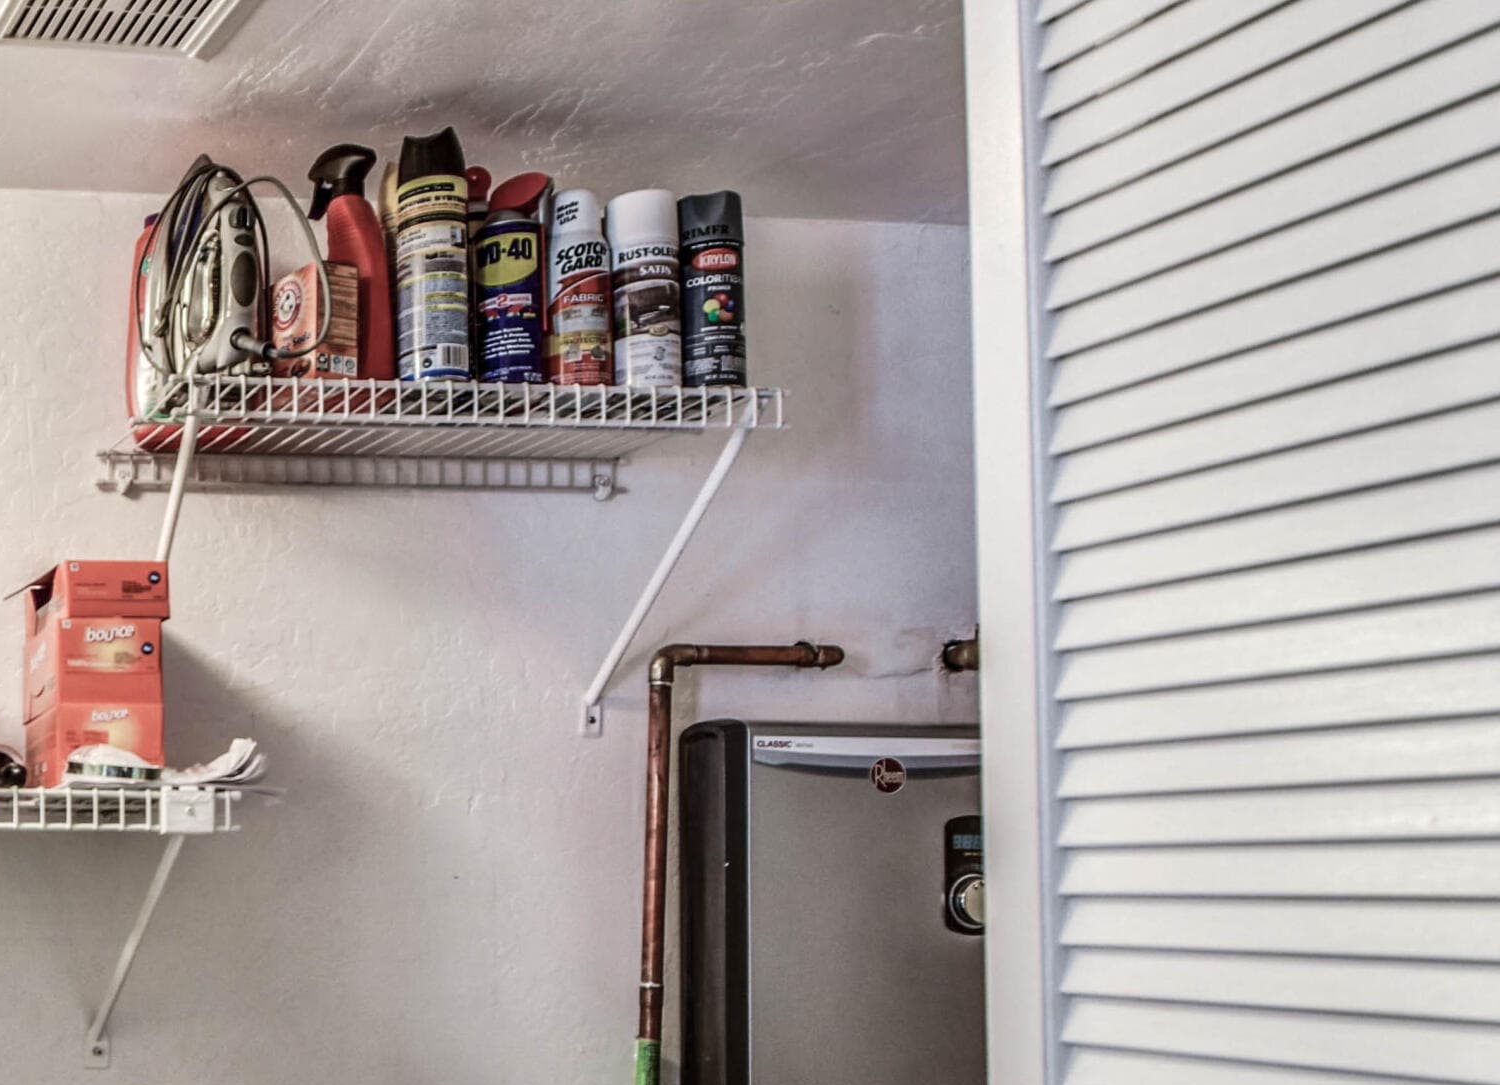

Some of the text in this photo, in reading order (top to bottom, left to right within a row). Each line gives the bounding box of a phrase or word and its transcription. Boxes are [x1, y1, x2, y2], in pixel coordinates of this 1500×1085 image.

[560, 213, 578, 226] USA
[683, 223, 730, 240] RIMER
[561, 255, 603, 275] GARD
[563, 293, 604, 304] FABRIC
[84, 624, 136, 643] bounce
[756, 740, 792, 748] CLASSIC
